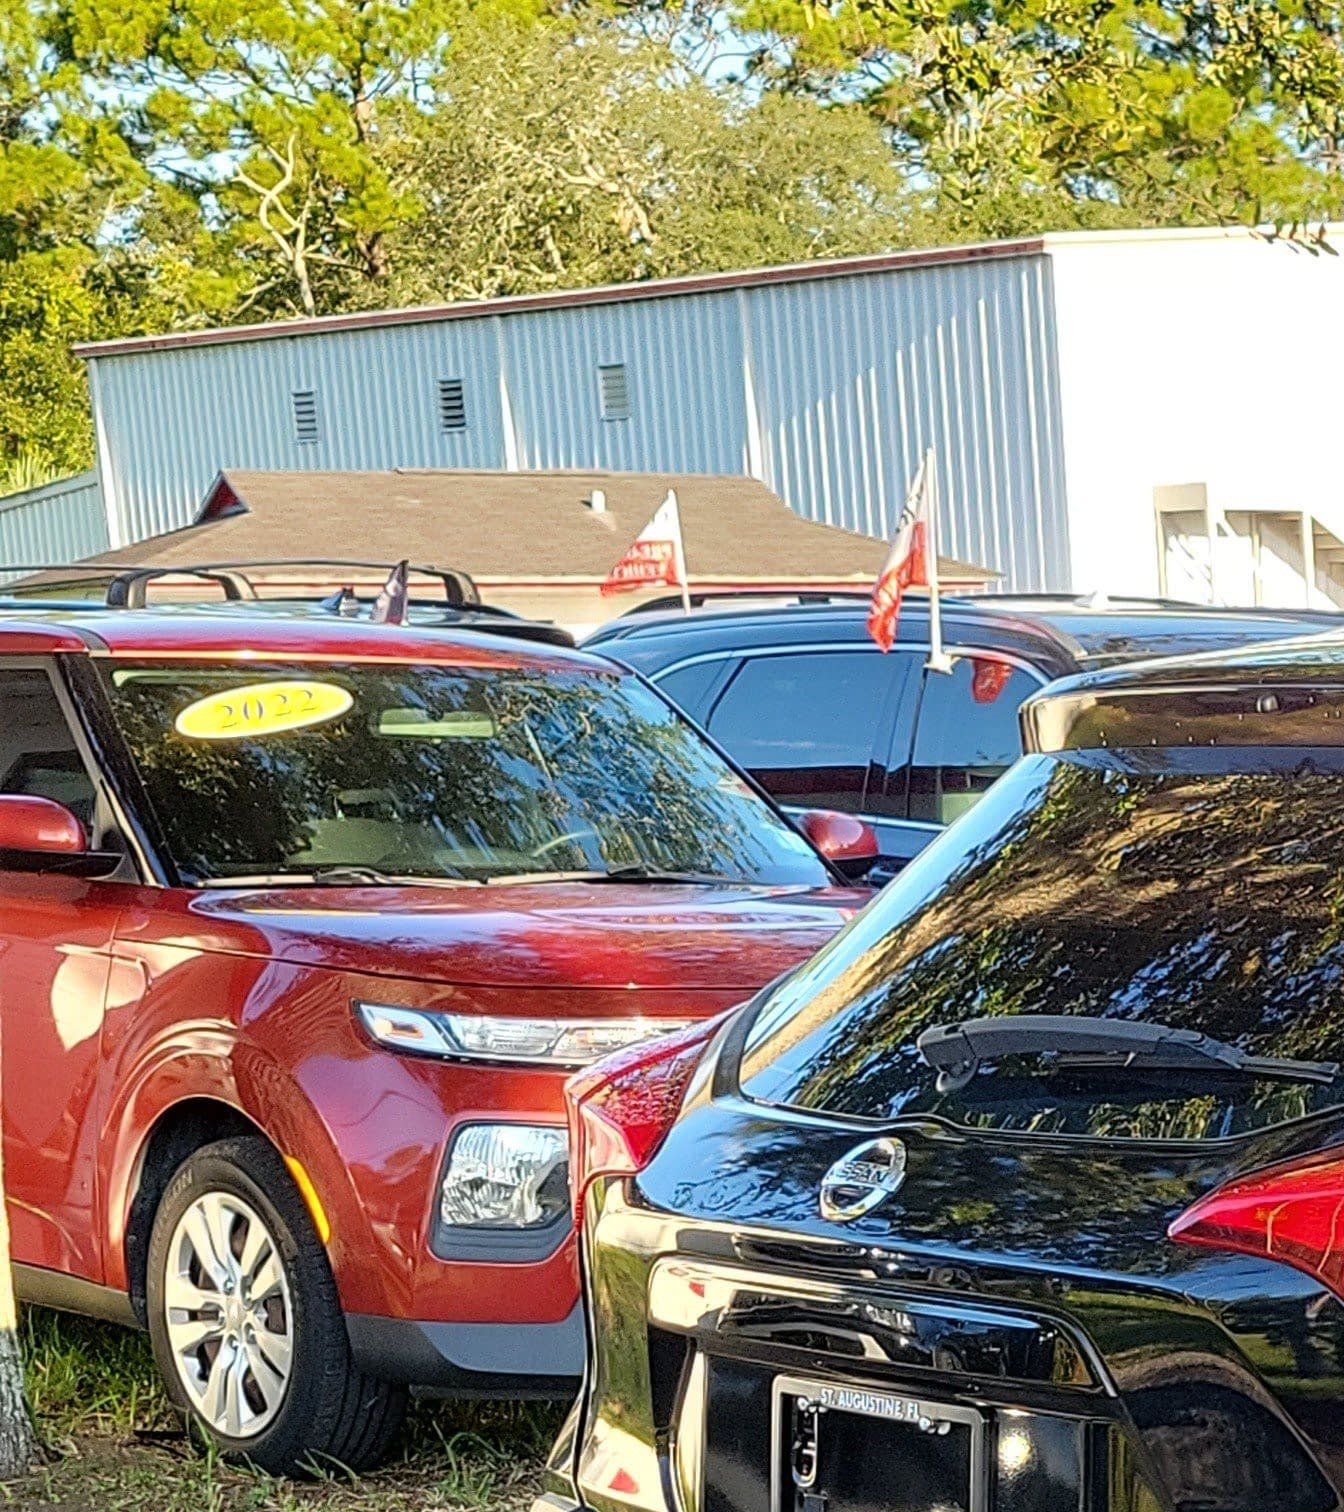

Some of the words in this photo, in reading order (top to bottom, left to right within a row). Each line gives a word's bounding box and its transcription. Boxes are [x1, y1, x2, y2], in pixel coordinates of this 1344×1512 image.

[218, 689, 317, 728] 2022
[820, 1388, 837, 1406] ST.
[838, 1391, 904, 1419] AUGUSTINE,
[907, 1402, 920, 1419] FL
